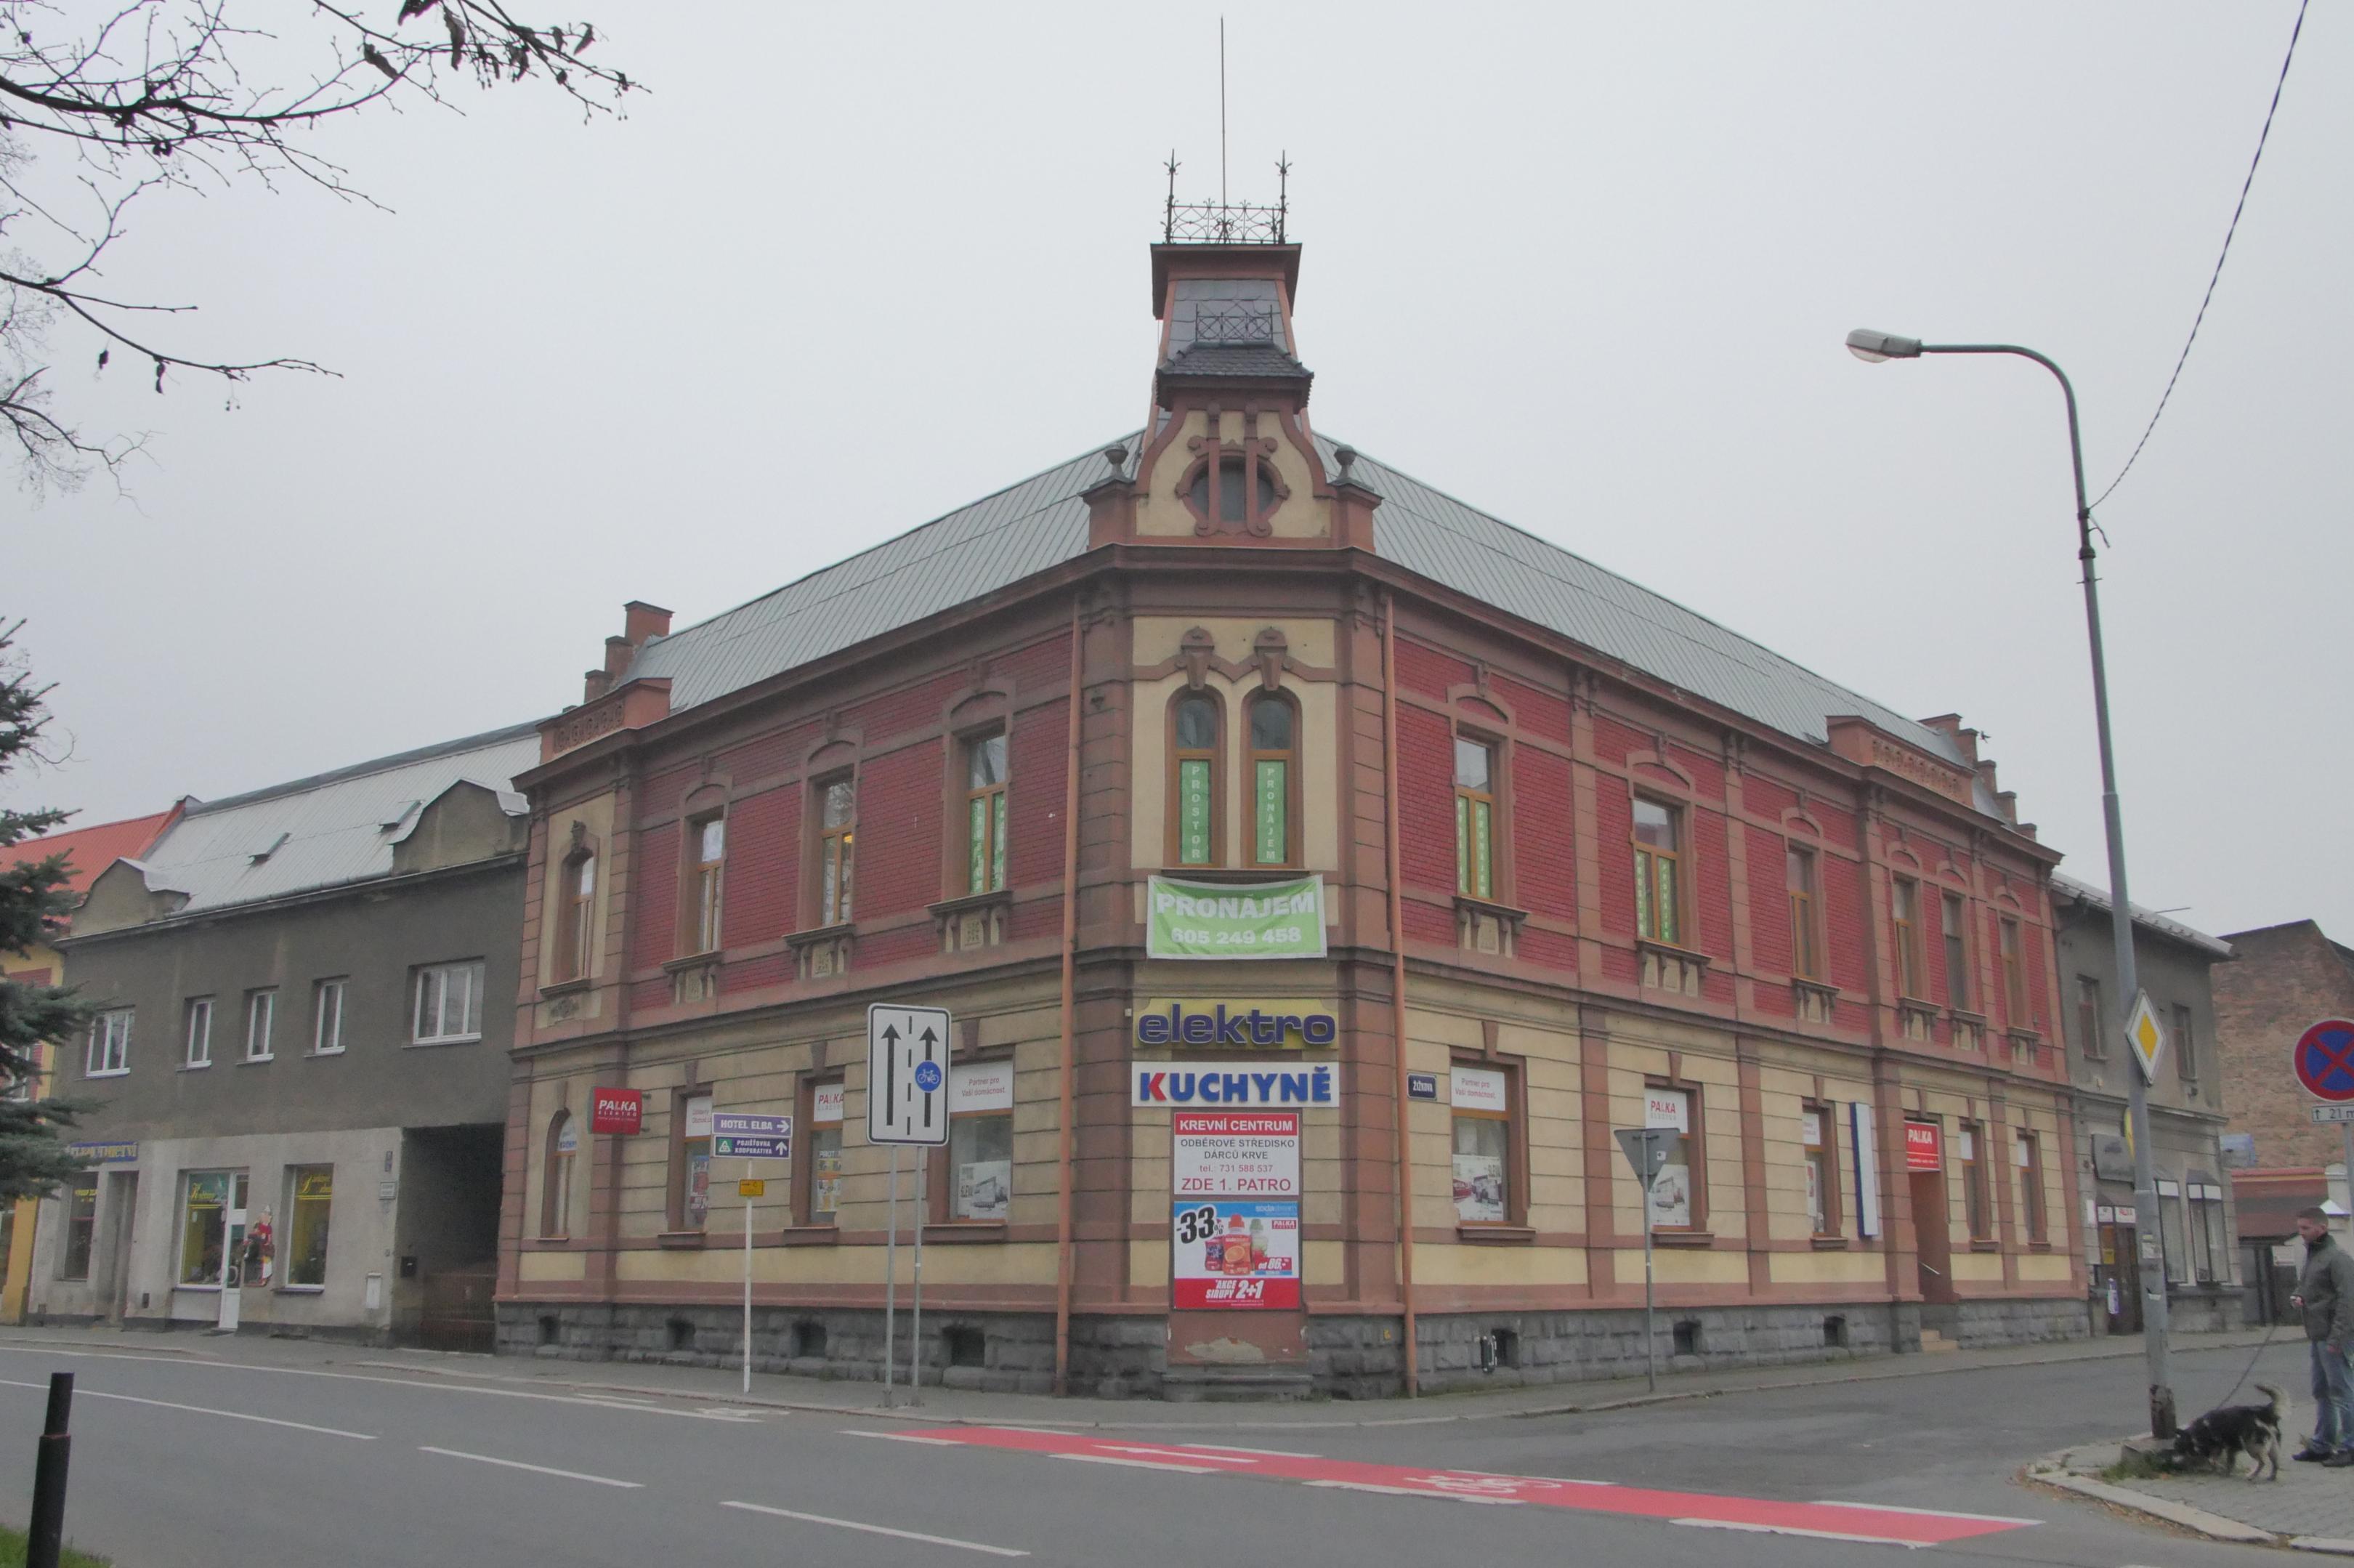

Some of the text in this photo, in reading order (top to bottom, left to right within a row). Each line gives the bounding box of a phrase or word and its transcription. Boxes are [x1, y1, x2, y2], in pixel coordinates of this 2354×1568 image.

[1191, 766, 1200, 858] PROSTOR
[1157, 892, 1316, 919] PRONÁJEM
[1171, 926, 1302, 945] 605 249 458
[1138, 1003, 1336, 1044] elektro
[990, 1077, 1000, 1086] pro
[1140, 1065, 1332, 1102] KUCHYNĚ
[599, 1099, 637, 1112] PALKA
[1650, 1100, 1676, 1114] PALKA
[2329, 1108, 2342, 1119] 21
[720, 1119, 749, 1129] HOTEL
[751, 1120, 773, 1131] ELBA
[1180, 1118, 1293, 1131] KREVNÍ CENTRUM
[736, 1138, 771, 1147] POJIŠŤOVNA
[1238, 1137, 1295, 1148] STŘEDISKO
[1908, 1128, 1933, 1145] PALKA
[735, 1146, 772, 1155] KOOPERATIVA
[1204, 1149, 1269, 1160] DÁRCŮ KRVE
[1220, 1164, 1235, 1173] 731
[1238, 1164, 1255, 1173] 588
[1257, 1164, 1274, 1173] 537
[1181, 1178, 1291, 1192] ZDE 1. PATRO
[1205, 1289, 1235, 1299] SIRUPY
[1236, 1280, 1264, 1299] 2+1
